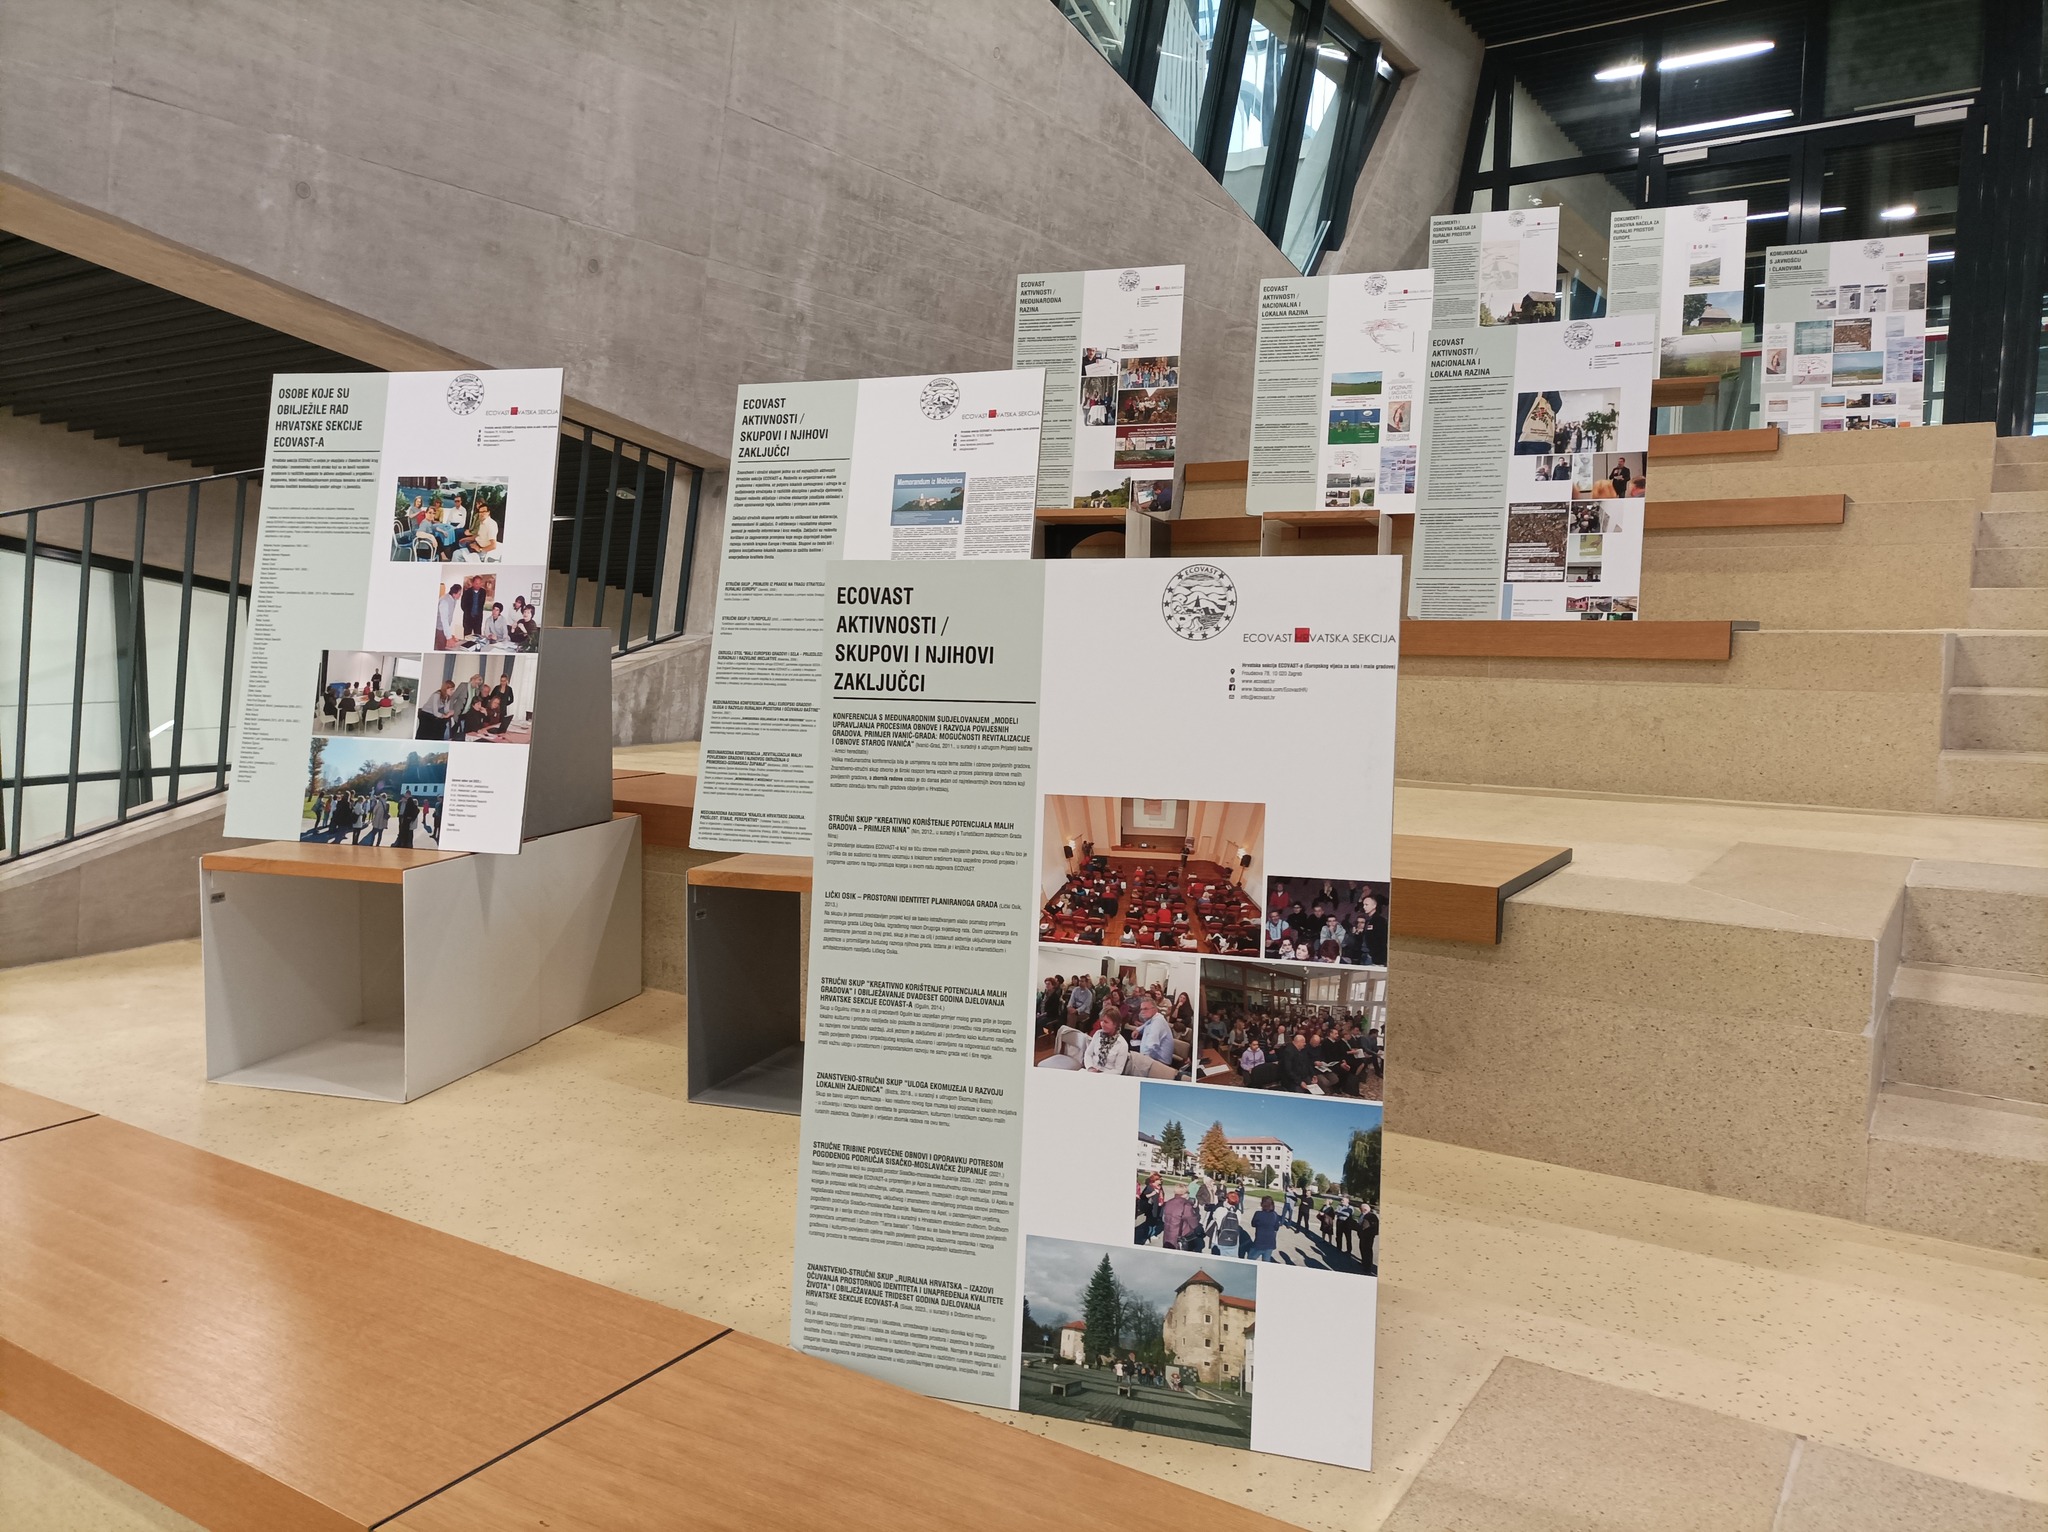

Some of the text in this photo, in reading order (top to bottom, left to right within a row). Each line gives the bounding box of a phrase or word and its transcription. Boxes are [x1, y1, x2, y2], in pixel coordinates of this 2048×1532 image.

[1432, 338, 1464, 346] ECOVAST
[1432, 348, 1474, 357] AKTIVNOSTI
[1430, 358, 1476, 368] NACIONALNA
[1430, 368, 1490, 378] LOKALNA RAZINA
[278, 388, 350, 399] OSOBE KOJE SU
[277, 402, 349, 415] OBILJEŽILE RAD
[743, 398, 786, 410] ECOVAST
[275, 420, 363, 431] HRVATSKE SEKCIJE
[742, 413, 798, 426] AKTIVNOSTI
[740, 428, 829, 442] SKUPOVI I NJIHOVI
[274, 436, 325, 448] ECOVAST-A
[738, 444, 790, 458] ZAKLJUČCI
[1185, 566, 1218, 576] ECOVAST
[837, 586, 914, 605] ECOVAST
[836, 616, 936, 634] AKTIVNOSTI
[1243, 633, 1293, 643] ECOVAST
[1352, 633, 1396, 644] SEKCIJA
[835, 644, 994, 664] SKUPOVI I NJIHOVI
[834, 670, 926, 692] ZAKLJUČCI
[832, 713, 878, 721] KONFERENCIJA
[884, 714, 936, 722] MEĐUNARODNIM
[936, 716, 990, 724] SUDJELOVANJEM
[876, 722, 912, 730] PROCESIMA
[836, 738, 860, 746] OBNOVE
[861, 738, 886, 747] STAROG
[864, 730, 891, 738] PRIMJER
[892, 731, 938, 740] IVANIĆ-GRADA:
[938, 732, 981, 741] MOGUĆNOSTI
[982, 734, 1030, 743] REVITALIZACIJE
[828, 814, 854, 822] STRUČNI
[856, 815, 873, 823] SKUP
[912, 817, 950, 827] KORIŠTENJE
[951, 820, 992, 828] POTENCIJALA
[994, 822, 1014, 830] MALIH
[828, 823, 857, 831] GRADOVA
[864, 824, 890, 832] PRIMJER
[824, 890, 998, 908] LIČKI OSIK PROSTORNI IDENTITET PLANIRANOGA GRADA
[820, 976, 848, 986] STRUČNI
[848, 978, 866, 987] SKUP
[904, 982, 942, 993] KORIŠTENJE
[944, 986, 986, 996] POTENCIJALA
[986, 990, 1008, 998] MALIH
[820, 994, 913, 1008] HRVATSKE SEKCIJE ECOVAST-A
[857, 988, 905, 999] OBILJEŽAVANJE
[906, 992, 938, 1001] DVADESET
[940, 994, 964, 1004] GODINA
[965, 996, 1005, 1006] DJELOVANJA
[816, 1072, 885, 1085] ZNANSTVENO-STRUČNI
[886, 1078, 904, 1086] SKUP
[930, 1082, 967, 1093] EKOMUZEJA
[974, 1087, 1004, 1097] RAZVOJU
[816, 1080, 846, 1090] LOKALNIH
[812, 1141, 841, 1151] STRUČNE
[842, 1144, 866, 1154] TRIBINE
[868, 1146, 904, 1158] POSVEĆENE
[904, 1150, 928, 1160] OBNOVI
[934, 1154, 968, 1165] OPORAVKU
[968, 1158, 1004, 1168] POTRESOM
[812, 1150, 988, 1176] POGOĐENOG PODRUČJA SISAČKO-MOSLAVAČKE ŽUPANIJE
[807, 1262, 876, 1278] ZNANSTVENO-STRUČNI
[876, 1272, 894, 1281] SKUP
[929, 1280, 963, 1290] HRVATSKA
[970, 1284, 994, 1295] IZAZOVI
[806, 1271, 838, 1283] OČUVANJA
[840, 1276, 882, 1289] PROSTORNOG
[882, 1282, 918, 1294] IDENTITETA
[923, 1288, 970, 1300] UNAPREĐENJA
[970, 1294, 1004, 1306] KVALITETE
[806, 1289, 899, 1308] HRVATSKE SEKCIJE ECOVAST-A
[836, 1284, 884, 1298] OBILJEŽAVANJE
[884, 1290, 914, 1302] TRIDESET
[916, 1295, 940, 1306] GODINA
[940, 1298, 981, 1311] DJELOVANJA
